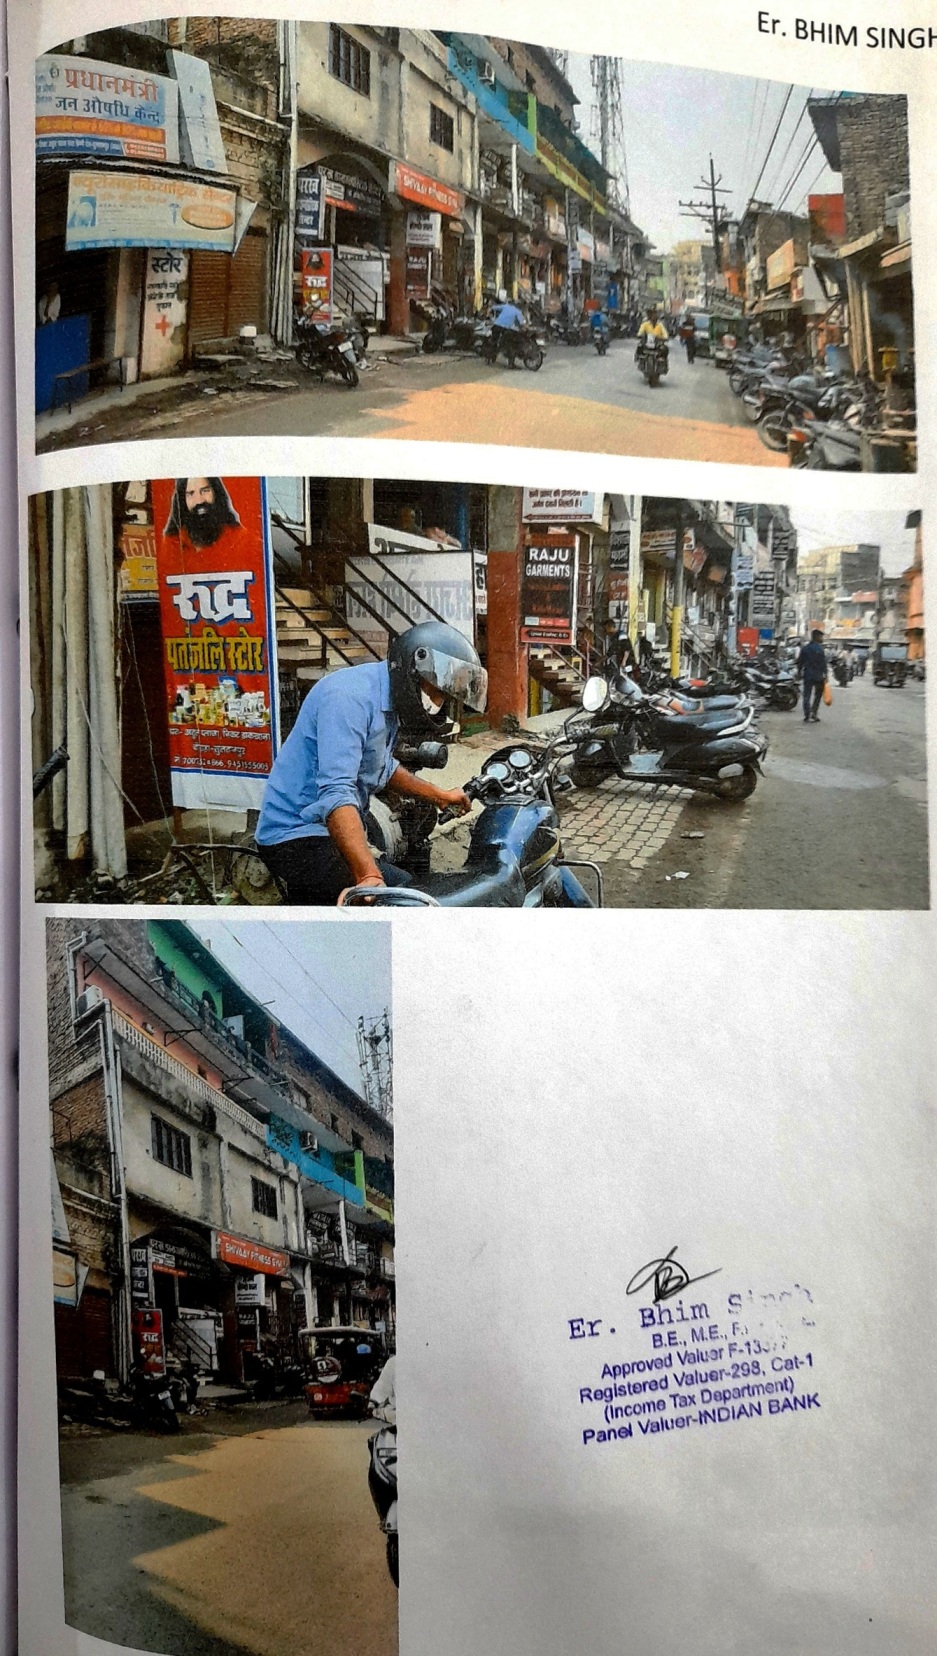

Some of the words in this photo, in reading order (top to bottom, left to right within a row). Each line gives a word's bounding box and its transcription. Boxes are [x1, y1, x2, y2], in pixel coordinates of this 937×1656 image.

[757, 11, 786, 37] Er.
[795, 18, 858, 47] BHIM
[64, 68, 159, 102] प्रधानमंत्री
[55, 96, 79, 112] जन
[151, 252, 184, 273] स्टोर
[525, 564, 571, 578] GARMENTS
[529, 547, 570, 562] RAJU
[165, 626, 226, 672] पतंजलि
[226, 626, 265, 672] स्टोर
[567, 1317, 616, 1340] Er.
[639, 1300, 710, 1328] Bhim
[652, 1331, 687, 1349] B.E.,
[579, 1374, 669, 1404] Registered
[673, 1360, 767, 1387] Valuer-298,
[771, 1352, 814, 1373] Cat-1
[601, 1352, 673, 1380] Approved
[677, 1346, 724, 1367] Valuer
[604, 1398, 666, 1424] (Income
[669, 1392, 697, 1410] Tax
[700, 1375, 795, 1405] Department)
[582, 1422, 633, 1445] Panel
[637, 1400, 763, 1435] Valuer-INDIAN
[768, 1392, 822, 1415] BANK
